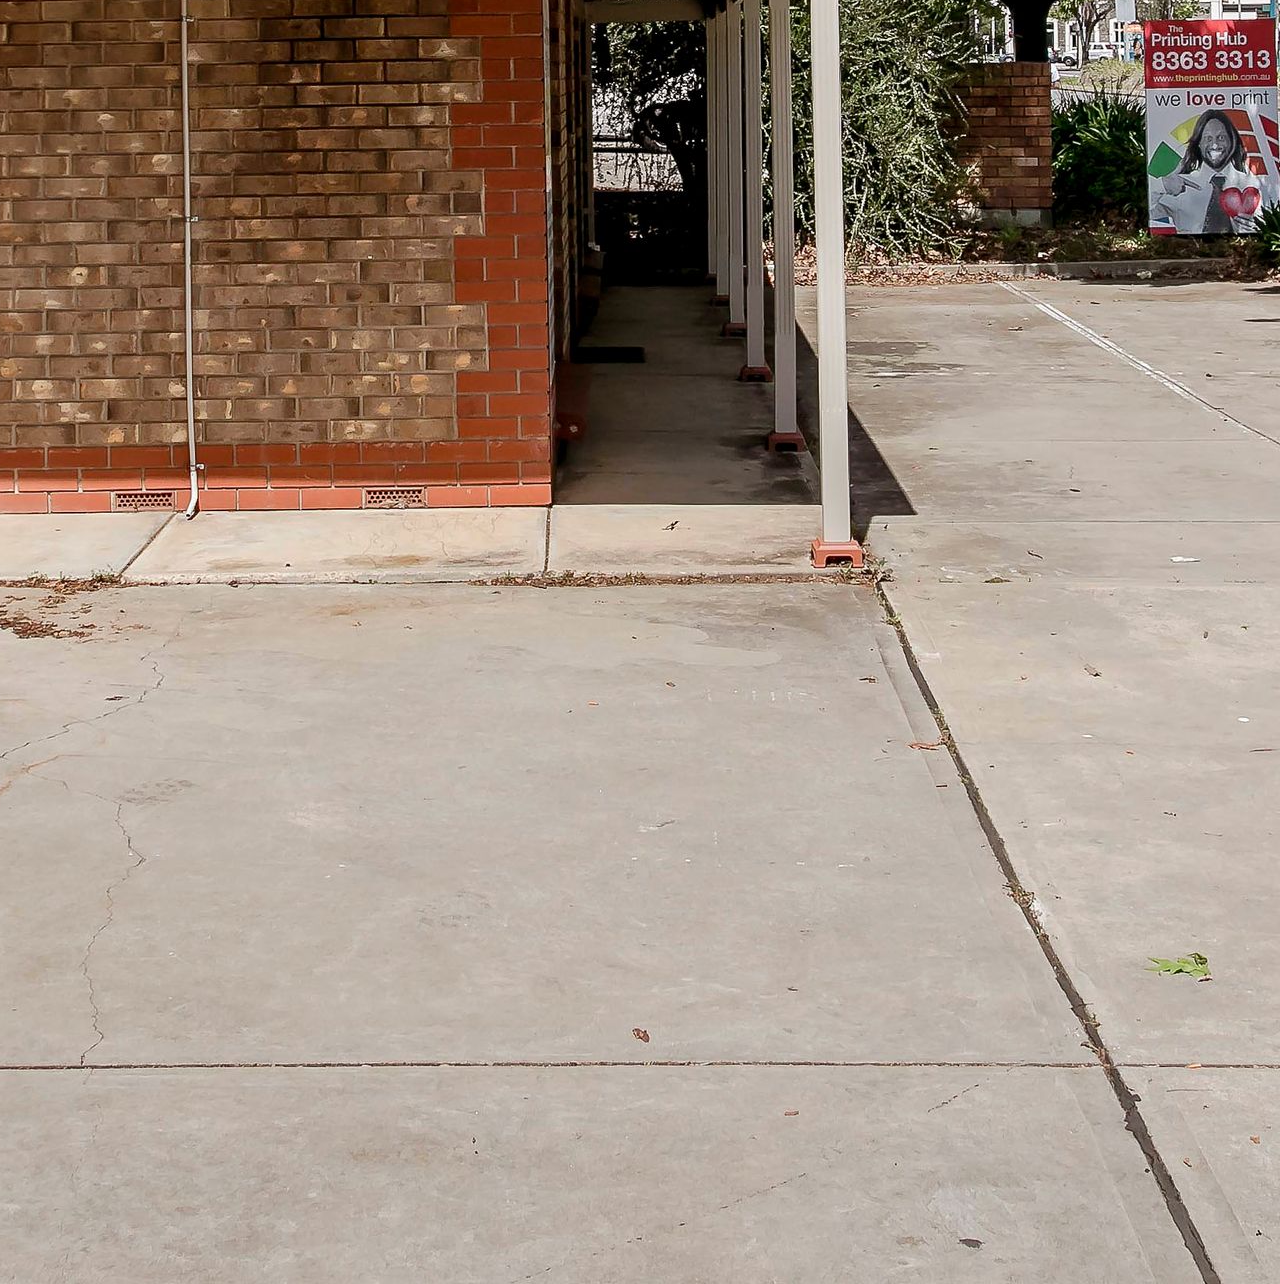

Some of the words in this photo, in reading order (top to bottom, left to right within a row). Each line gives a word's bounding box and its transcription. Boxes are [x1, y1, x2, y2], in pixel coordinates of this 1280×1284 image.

[1168, 24, 1184, 33] The
[1151, 32, 1212, 50] Printing
[1215, 31, 1248, 46] Hub
[1151, 51, 1208, 71] 8363
[1215, 49, 1271, 69] 3313
[1153, 73, 1271, 83] www.theprintinghub.com.au
[1155, 94, 1181, 107] we
[1186, 90, 1226, 106] love
[1231, 89, 1270, 108] print
